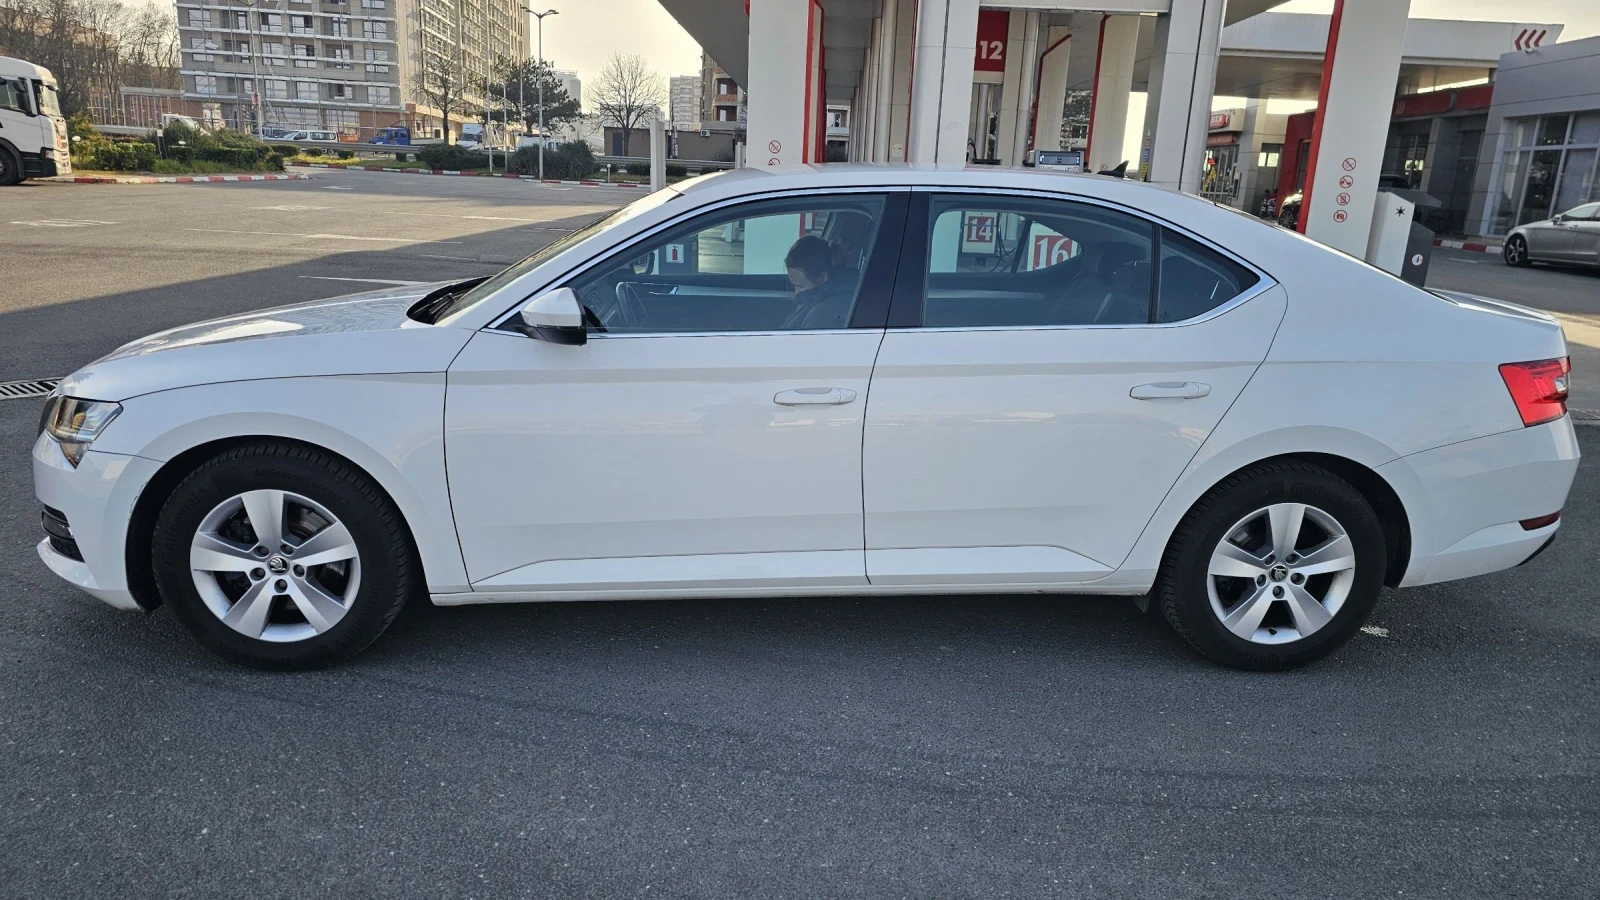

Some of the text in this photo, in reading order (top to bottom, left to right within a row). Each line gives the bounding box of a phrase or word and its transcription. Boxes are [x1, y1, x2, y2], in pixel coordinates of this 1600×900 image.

[980, 41, 1003, 59] 12
[968, 217, 992, 241] 14
[1034, 237, 1070, 270] 16
